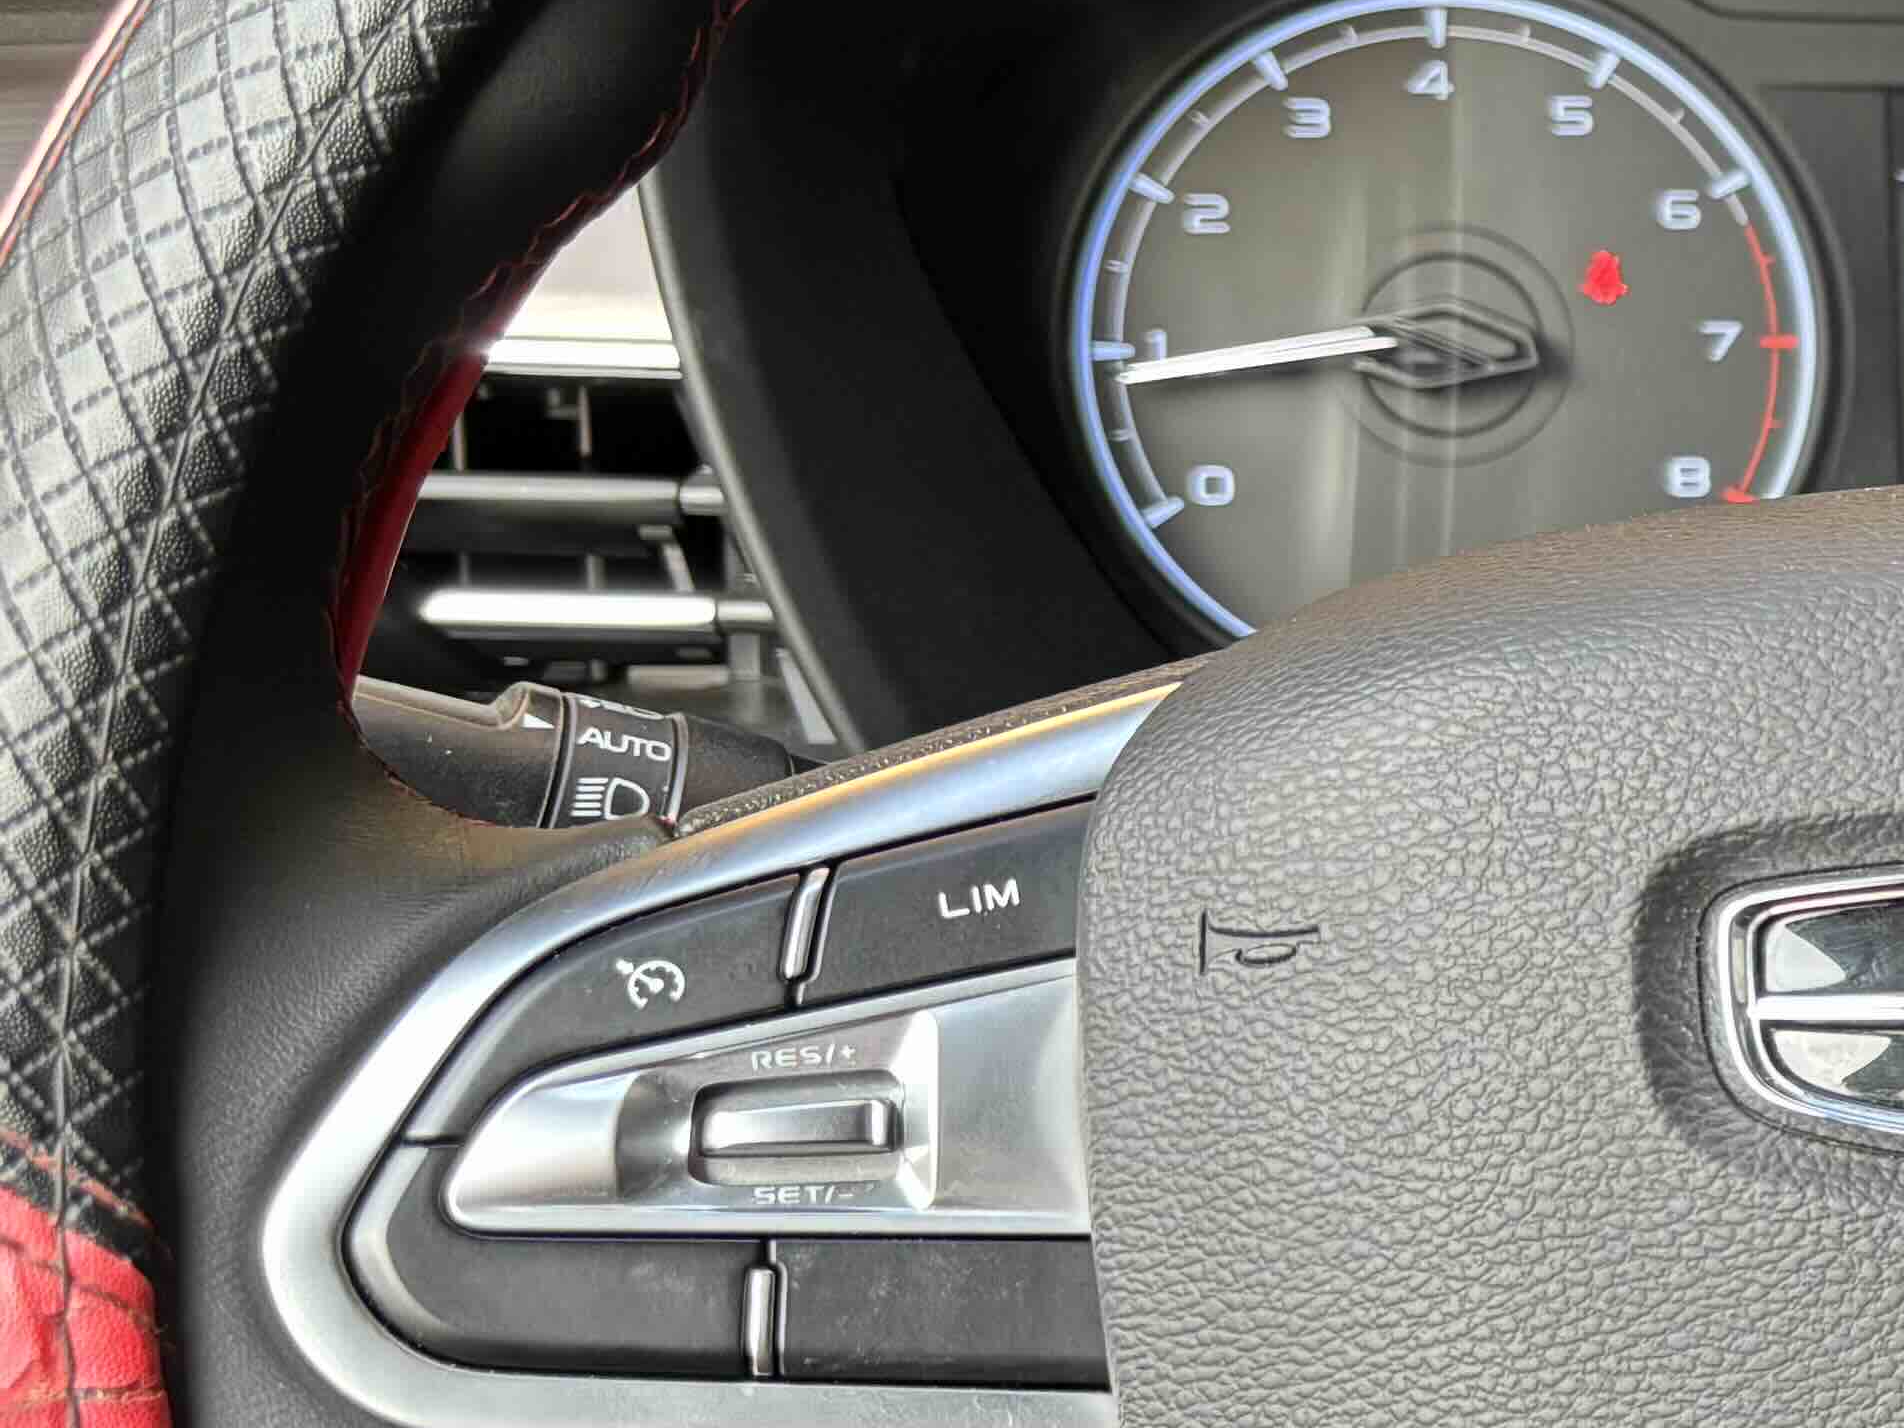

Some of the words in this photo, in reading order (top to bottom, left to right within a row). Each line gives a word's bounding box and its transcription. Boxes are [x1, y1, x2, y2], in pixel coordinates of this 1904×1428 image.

[1408, 60, 1452, 101] 4
[1283, 96, 1332, 138] 3
[1549, 95, 1594, 137] 5
[1182, 192, 1232, 235] 2
[1658, 190, 1702, 230] 6
[1700, 320, 1743, 362] 7
[1188, 465, 1236, 506] 0
[1664, 457, 1711, 498] 8
[577, 726, 673, 763] AUTO
[936, 877, 1020, 919] LIM
